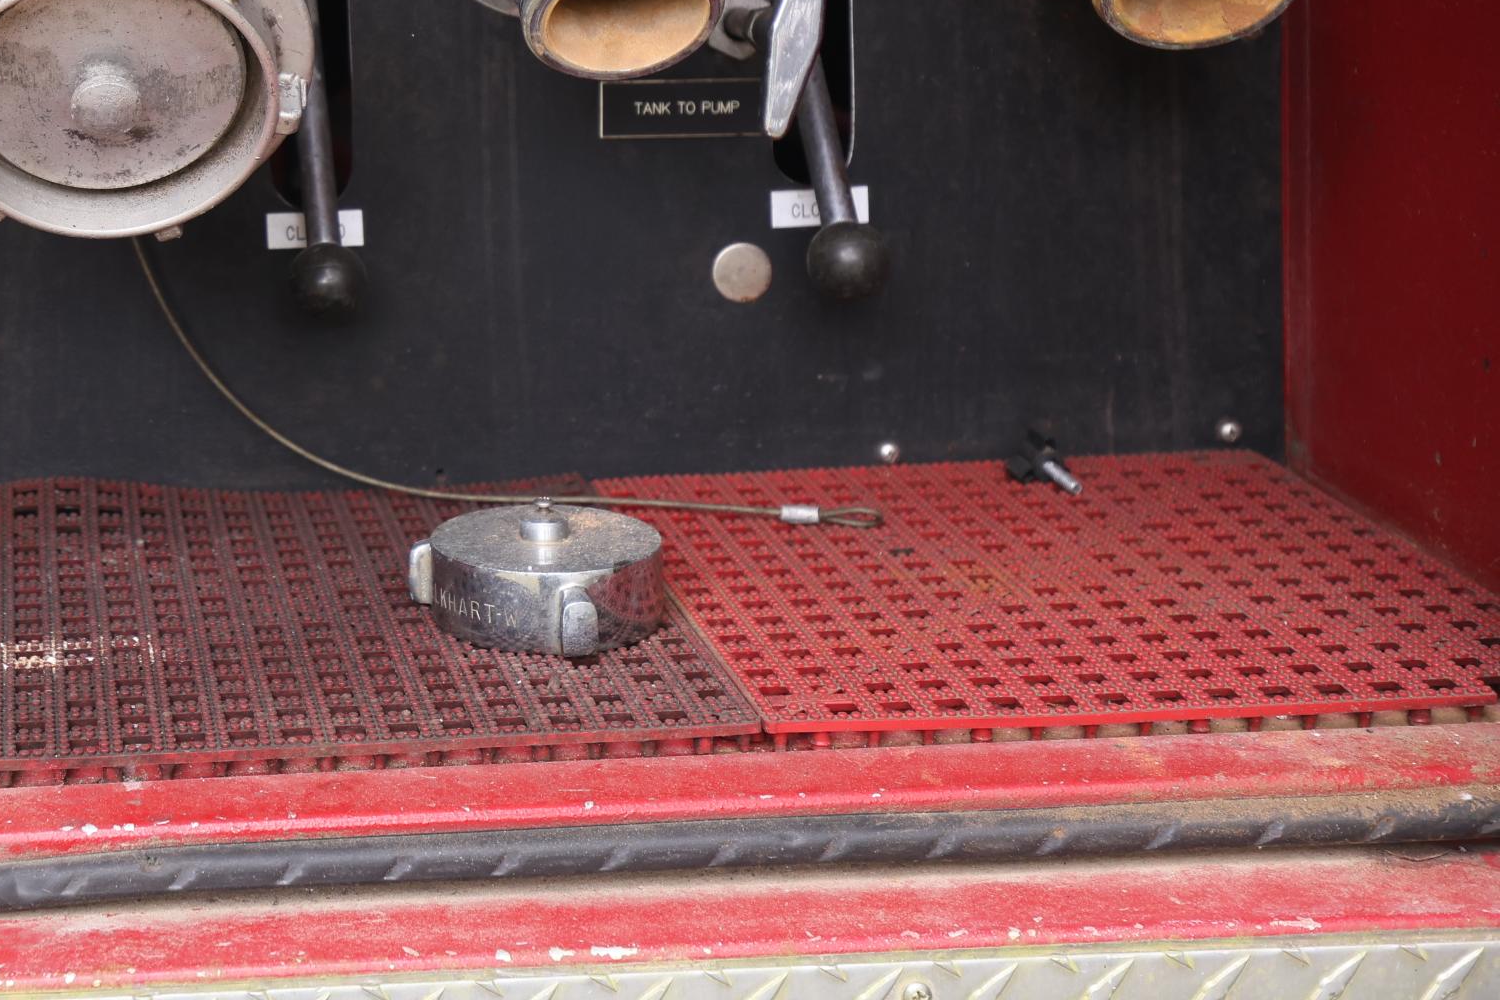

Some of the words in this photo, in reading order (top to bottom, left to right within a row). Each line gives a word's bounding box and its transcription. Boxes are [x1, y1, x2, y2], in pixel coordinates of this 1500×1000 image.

[634, 101, 671, 115] TANK
[677, 101, 696, 115] TO
[702, 99, 740, 114] PUMP
